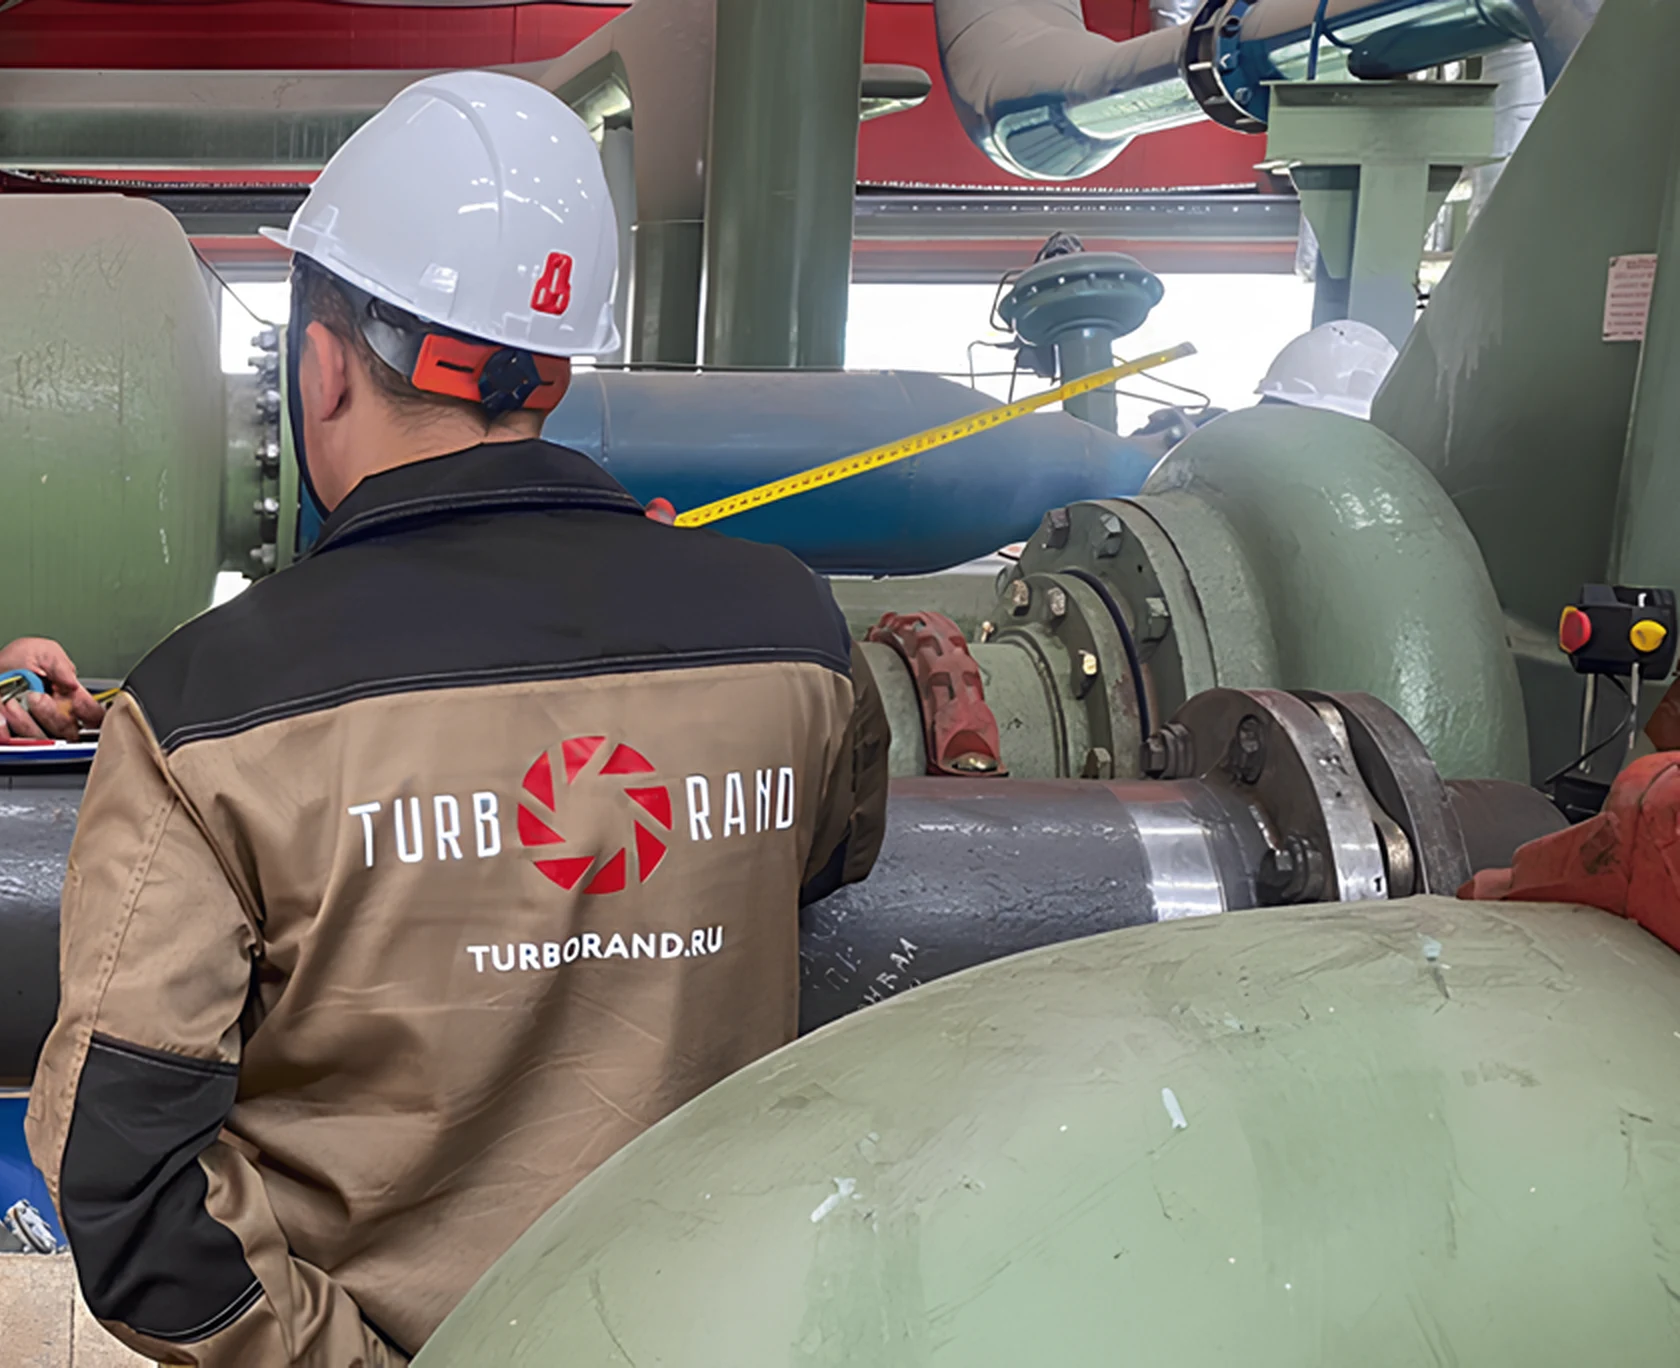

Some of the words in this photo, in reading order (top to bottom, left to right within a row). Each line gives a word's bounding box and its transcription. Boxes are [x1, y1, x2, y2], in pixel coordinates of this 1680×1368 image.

[348, 791, 501, 867] TURB
[685, 767, 795, 841] RAND
[467, 926, 723, 972] TURBORAND.RU
